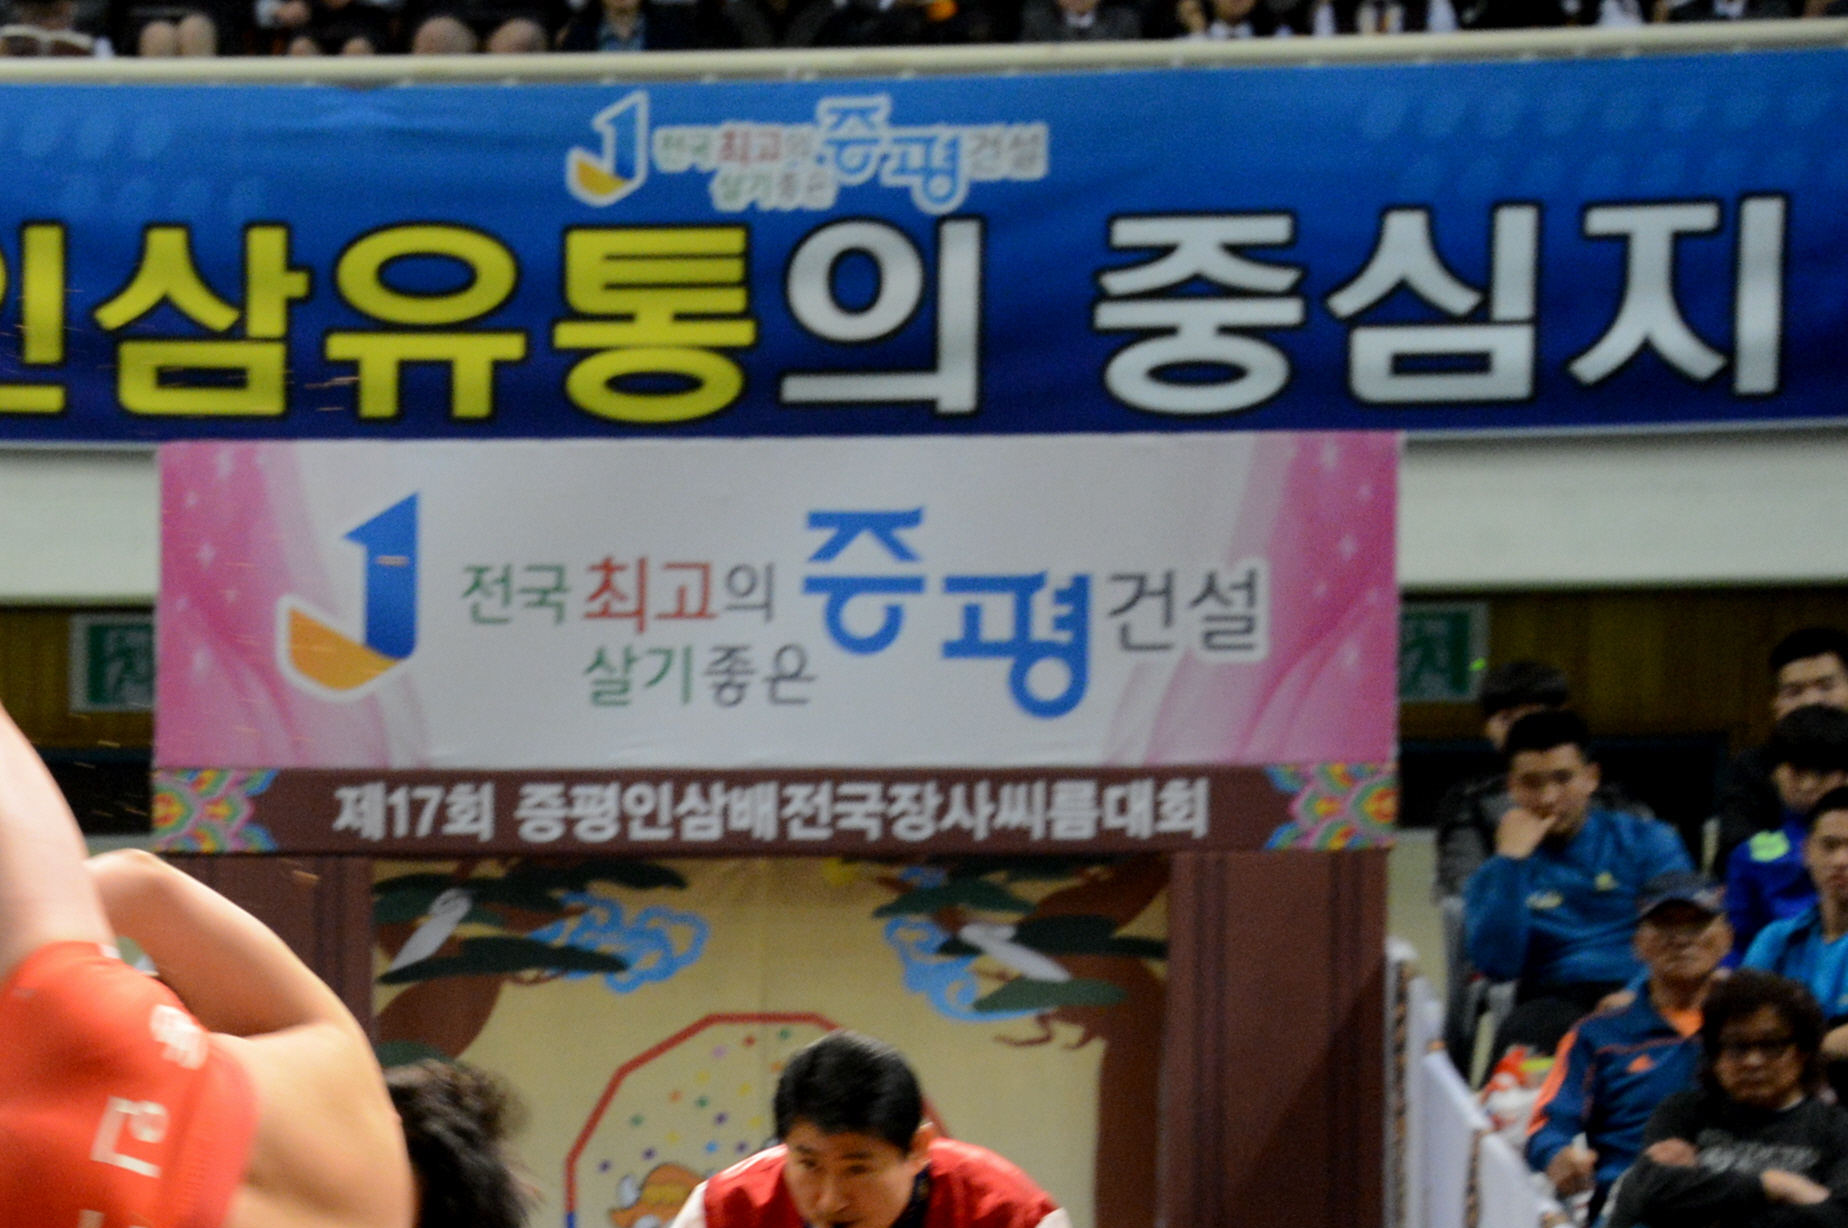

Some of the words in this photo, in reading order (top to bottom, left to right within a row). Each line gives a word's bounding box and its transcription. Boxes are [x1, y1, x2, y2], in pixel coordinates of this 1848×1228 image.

[1092, 194, 1788, 416] 중심지
[462, 563, 572, 625] 전국
[582, 556, 776, 634] 최고의
[802, 506, 1091, 719] 증평
[1108, 566, 1260, 653] 건설
[585, 644, 816, 708] 살기좋은
[332, 781, 496, 842] 제17회
